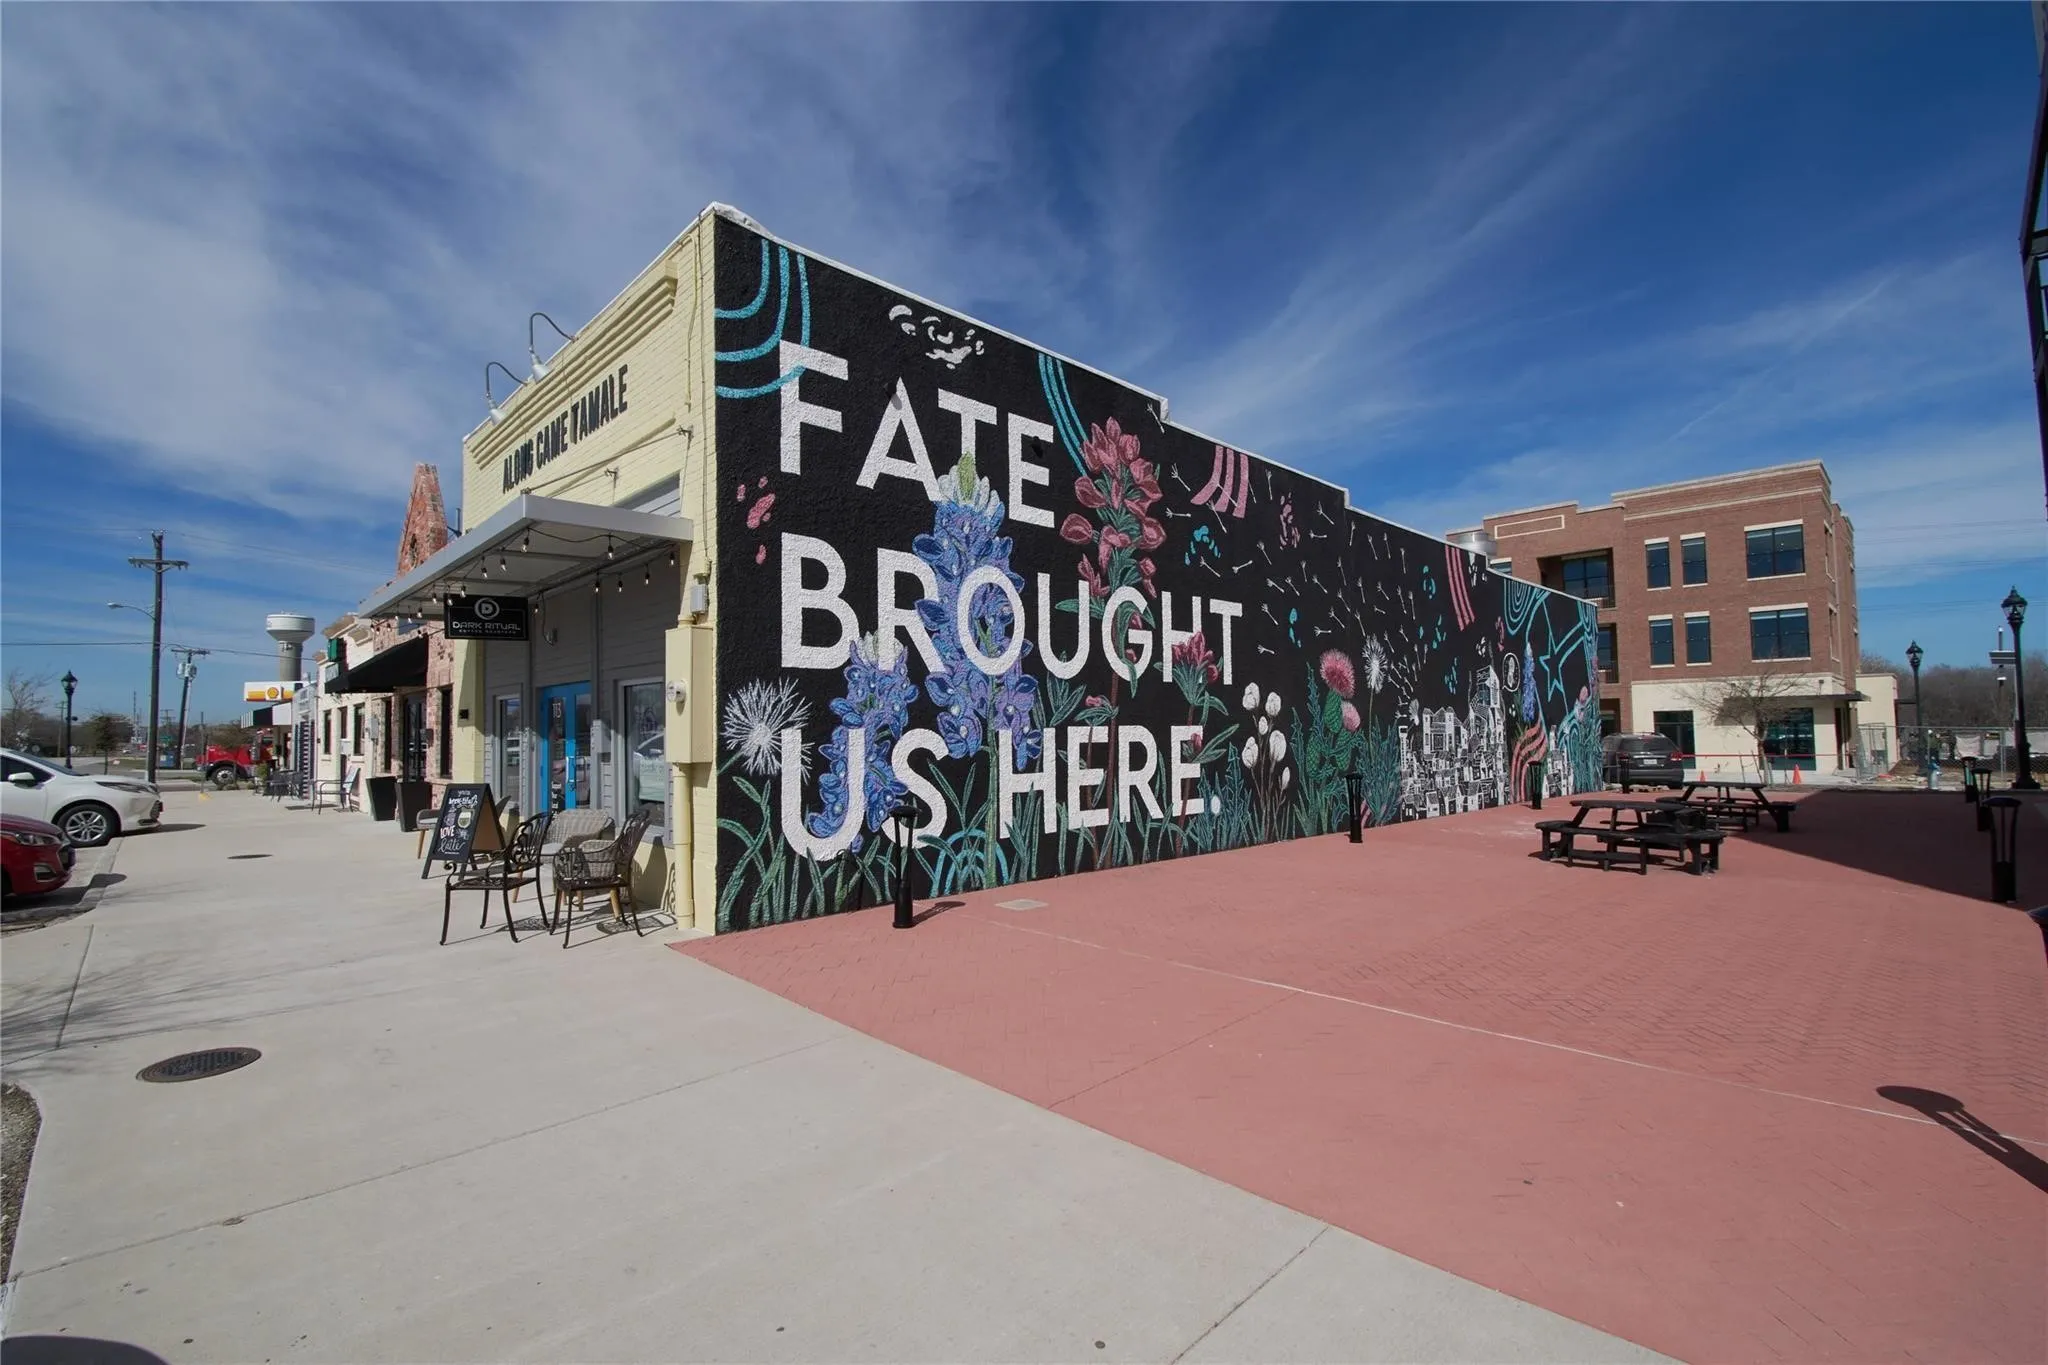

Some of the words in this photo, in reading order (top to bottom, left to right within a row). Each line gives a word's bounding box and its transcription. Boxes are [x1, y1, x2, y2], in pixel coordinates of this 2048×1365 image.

[502, 438, 534, 494] ALONG
[536, 410, 569, 470] CAME
[571, 363, 628, 444] TAMALE
[780, 339, 1055, 528] FATE
[452, 621, 483, 630] DARK
[484, 622, 521, 631] RITUAL
[780, 532, 1243, 686] BROUGHT
[440, 825, 456, 839] LOVE
[780, 725, 950, 861] US
